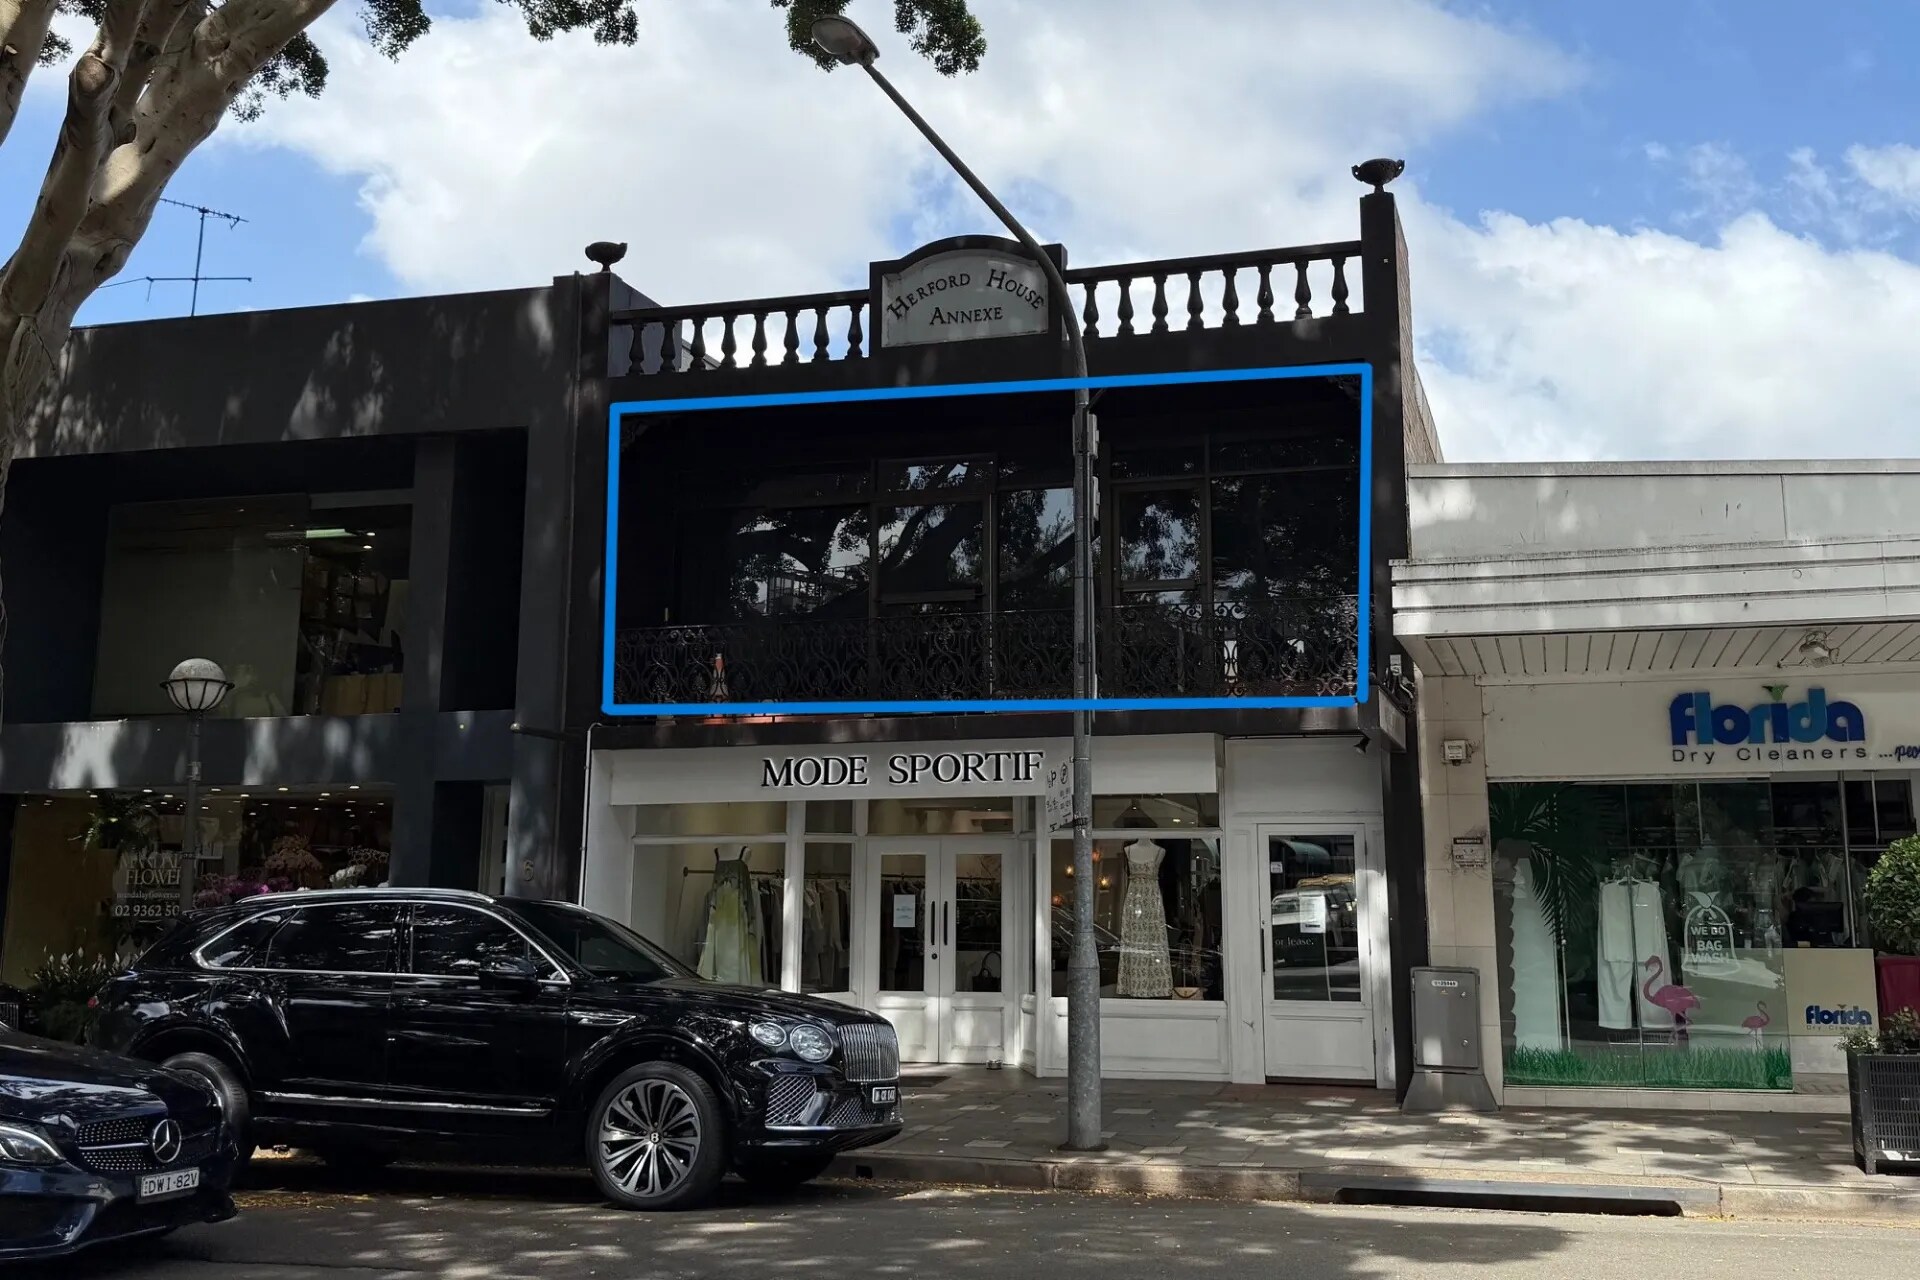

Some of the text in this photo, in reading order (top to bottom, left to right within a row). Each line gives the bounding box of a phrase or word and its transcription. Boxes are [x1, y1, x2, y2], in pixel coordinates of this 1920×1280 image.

[888, 268, 1045, 320] HERFORD HOUSE
[929, 306, 1003, 326] ANNEXE
[1669, 684, 1866, 746] florida
[1672, 748, 1716, 764] Dry
[1736, 746, 1867, 762] Cleaners
[761, 751, 1044, 787] MODE SPORTIF
[114, 904, 131, 917] 02
[132, 904, 163, 917] 9362
[1690, 926, 1726, 936] WE DO
[1696, 940, 1723, 951] BAG
[1690, 952, 1730, 964] WASH
[1805, 1003, 1873, 1025] florida
